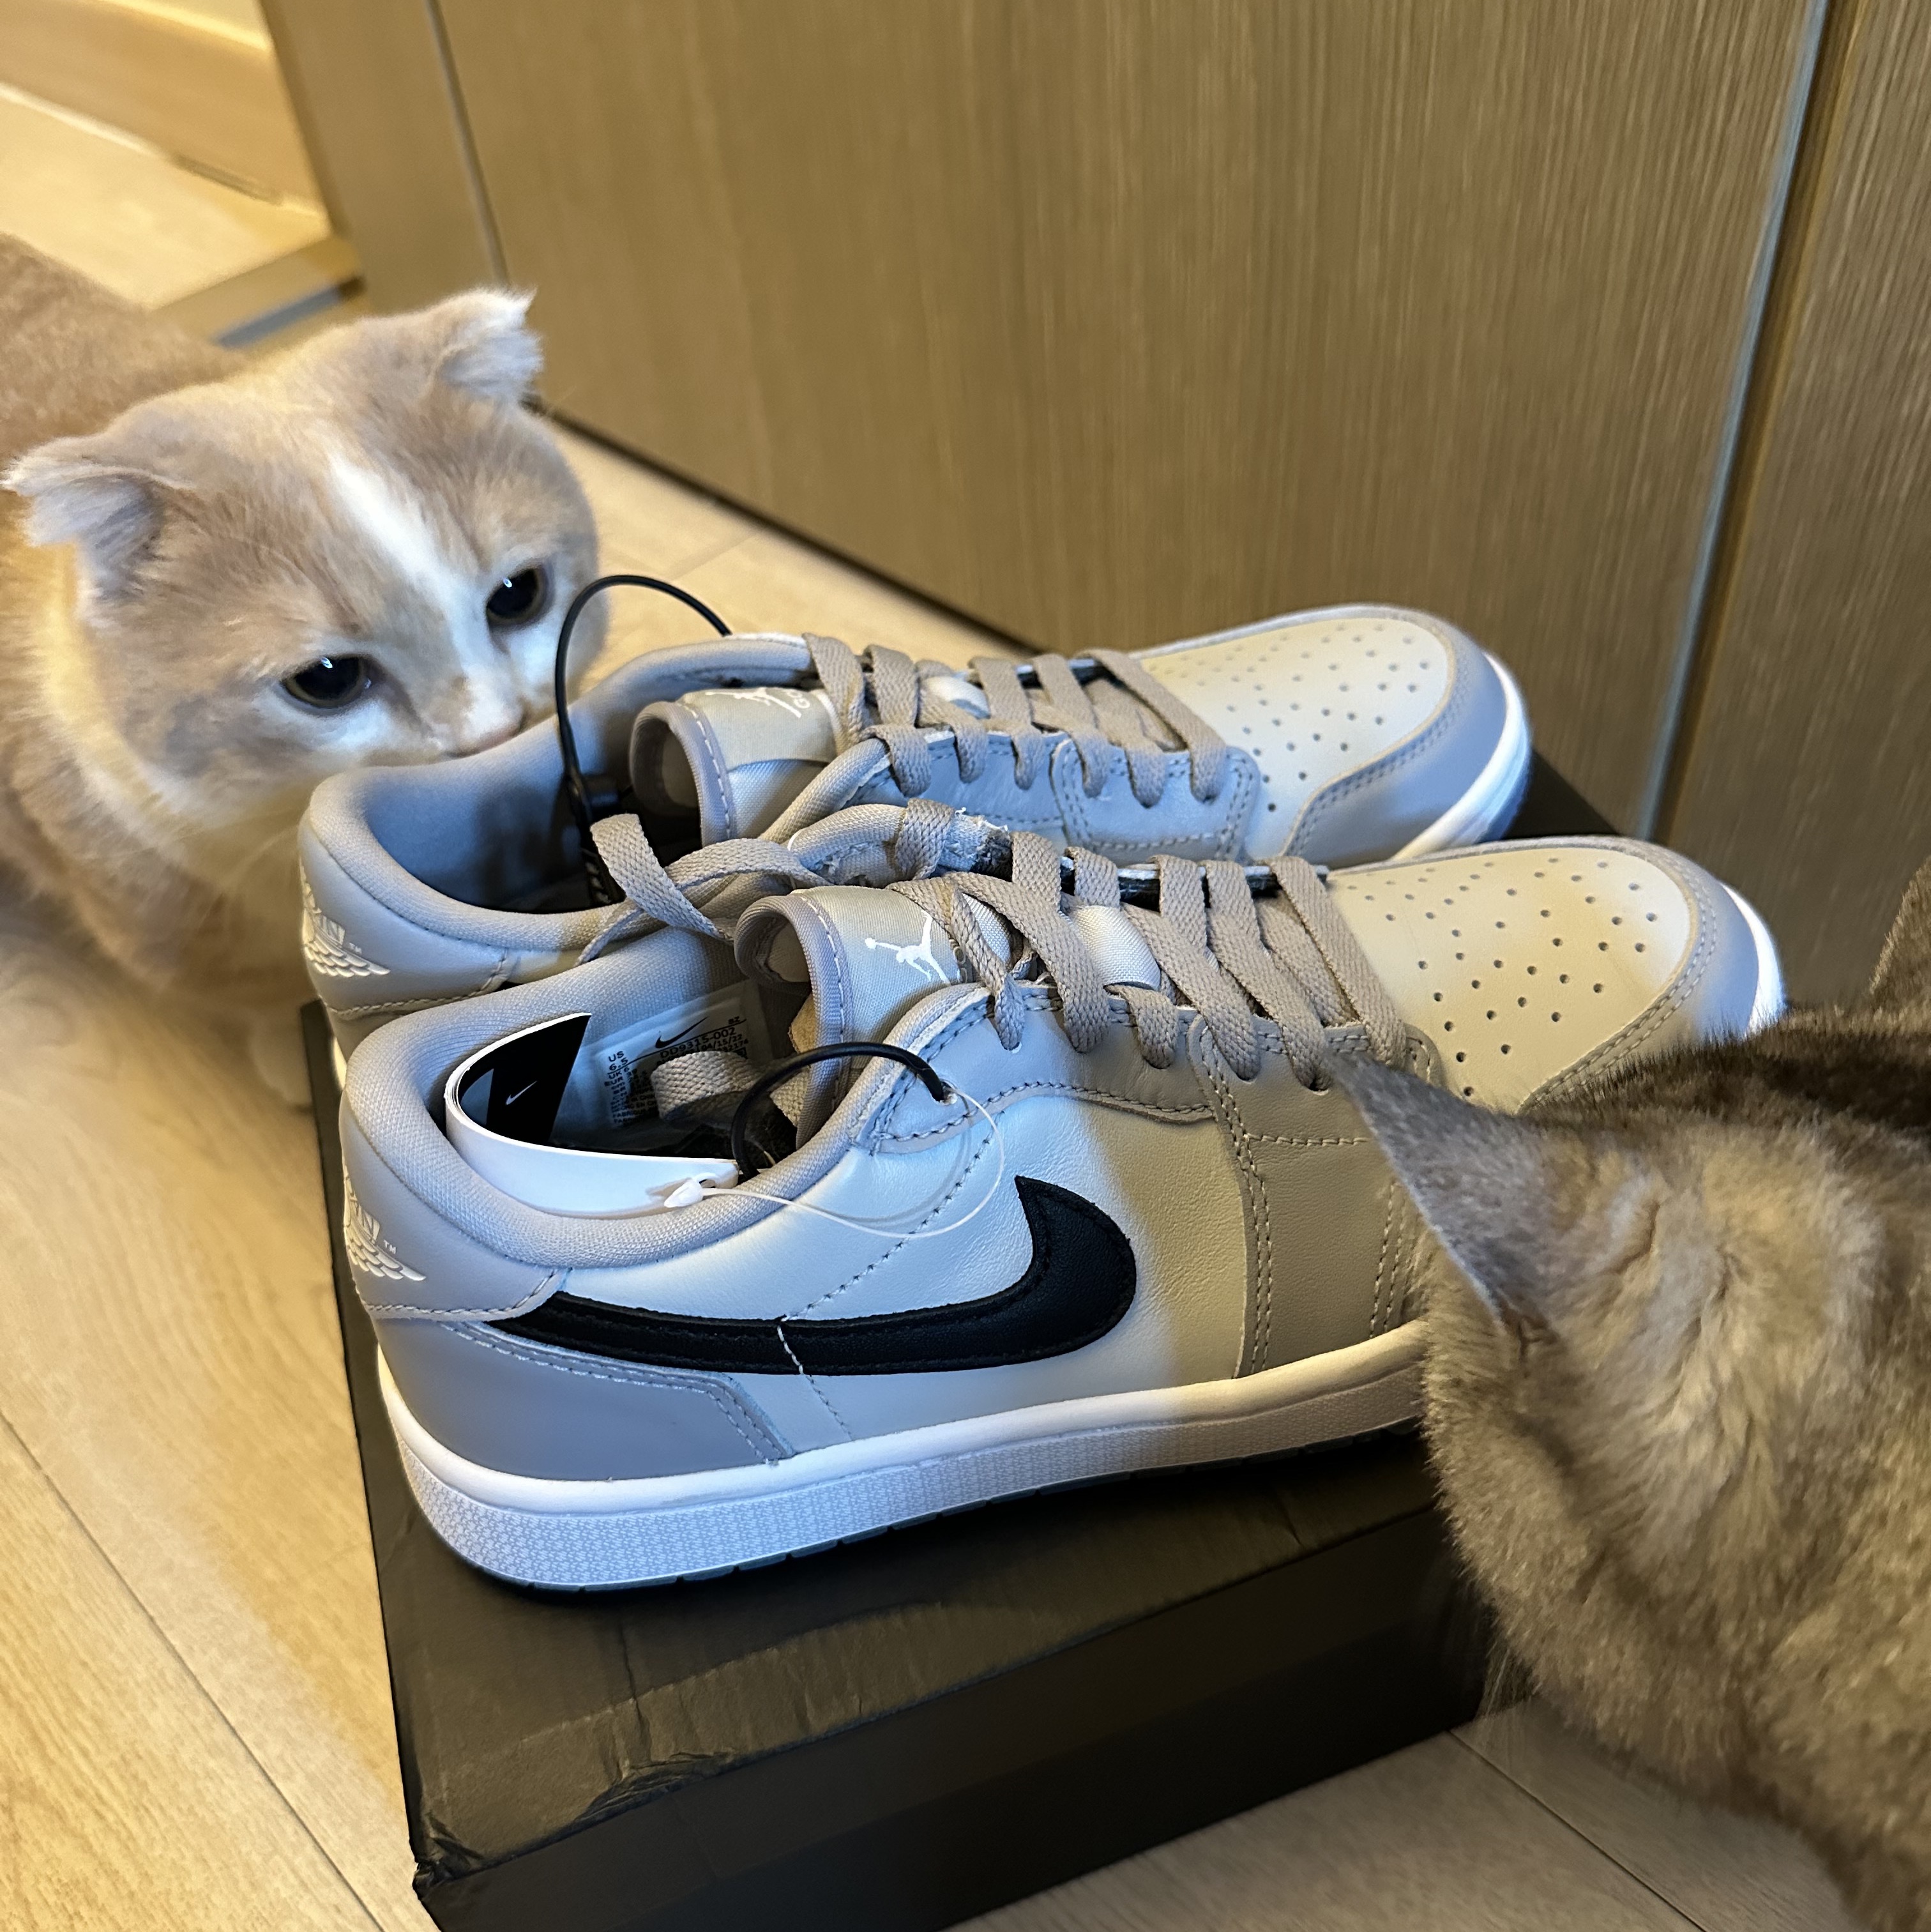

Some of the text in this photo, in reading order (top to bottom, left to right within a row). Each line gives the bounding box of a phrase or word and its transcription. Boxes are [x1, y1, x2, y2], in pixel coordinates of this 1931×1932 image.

[660, 1026, 736, 1058] DD9315-002
[609, 1051, 625, 1062] US
[609, 1057, 628, 1071] 6.5
[609, 1070, 623, 1079] UK
[383, 1239, 397, 1255] TM
